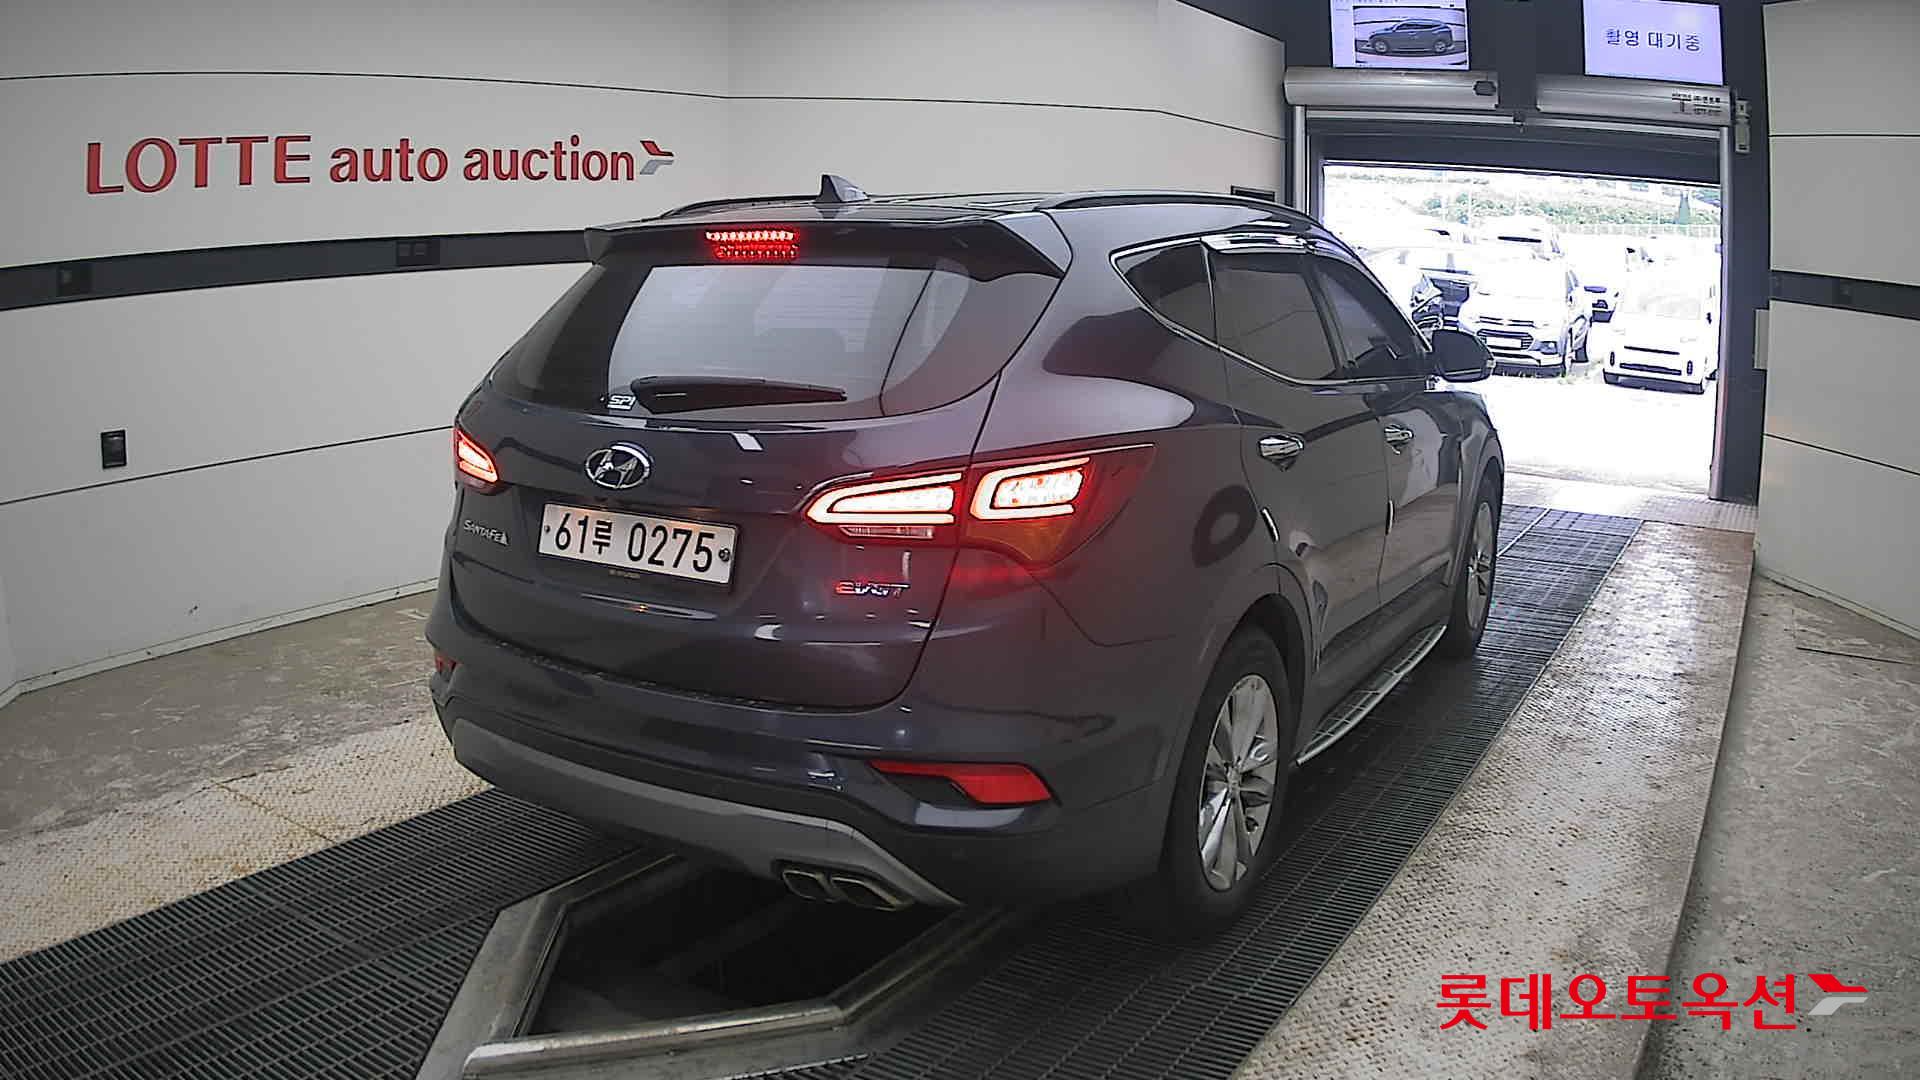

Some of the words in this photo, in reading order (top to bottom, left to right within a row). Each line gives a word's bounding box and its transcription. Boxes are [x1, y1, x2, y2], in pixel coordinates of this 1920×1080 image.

[1606, 28, 1640, 47] 촬영
[1647, 31, 1701, 52] 대기중
[86, 134, 312, 195] LOTTE
[328, 137, 449, 184] auto
[463, 134, 635, 182] auction
[554, 512, 613, 555] 61루
[627, 522, 716, 573] 0275
